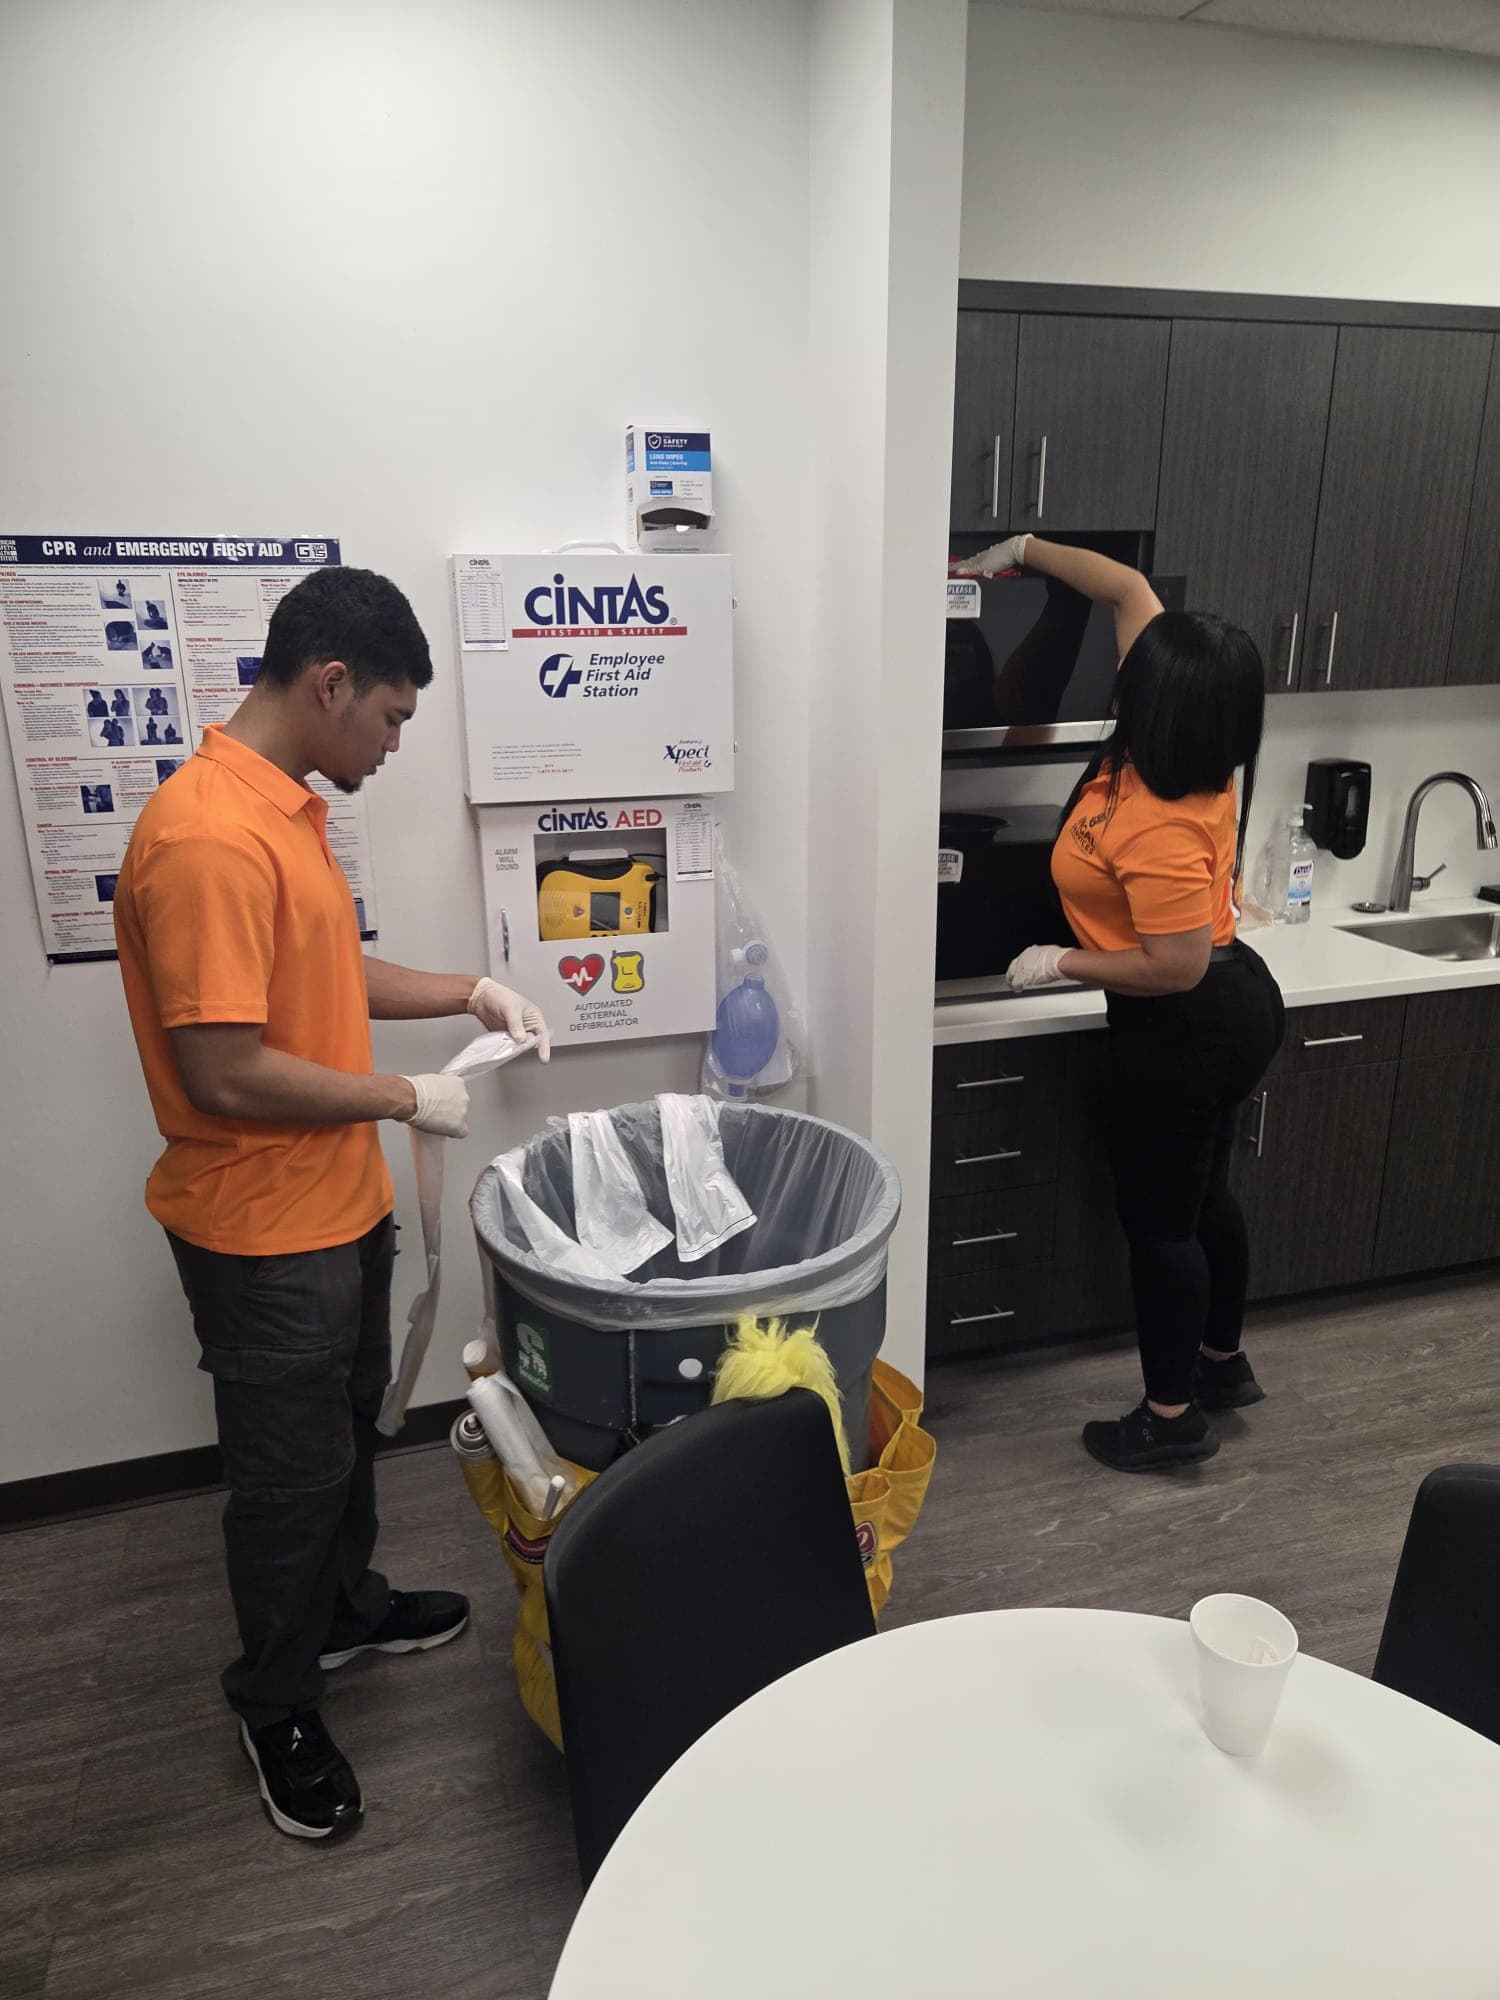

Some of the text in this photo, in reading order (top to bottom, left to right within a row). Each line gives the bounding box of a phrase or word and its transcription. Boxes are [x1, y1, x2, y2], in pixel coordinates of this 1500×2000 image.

[42, 541, 283, 557] CPR and EMERGENCY FIRST AID
[537, 629, 572, 637] FIRST
[607, 628, 614, 636] &
[621, 628, 664, 636] SAFETY
[590, 652, 665, 668] Employee
[586, 667, 651, 682] First Aid
[582, 684, 638, 698] Station
[615, 809, 662, 828] AED
[495, 863, 520, 871] SOUND
[574, 999, 633, 1011] AUTOMATED
[580, 1009, 628, 1021] EXTERNAL
[569, 1017, 639, 1032] DEFIBRILLATOR
